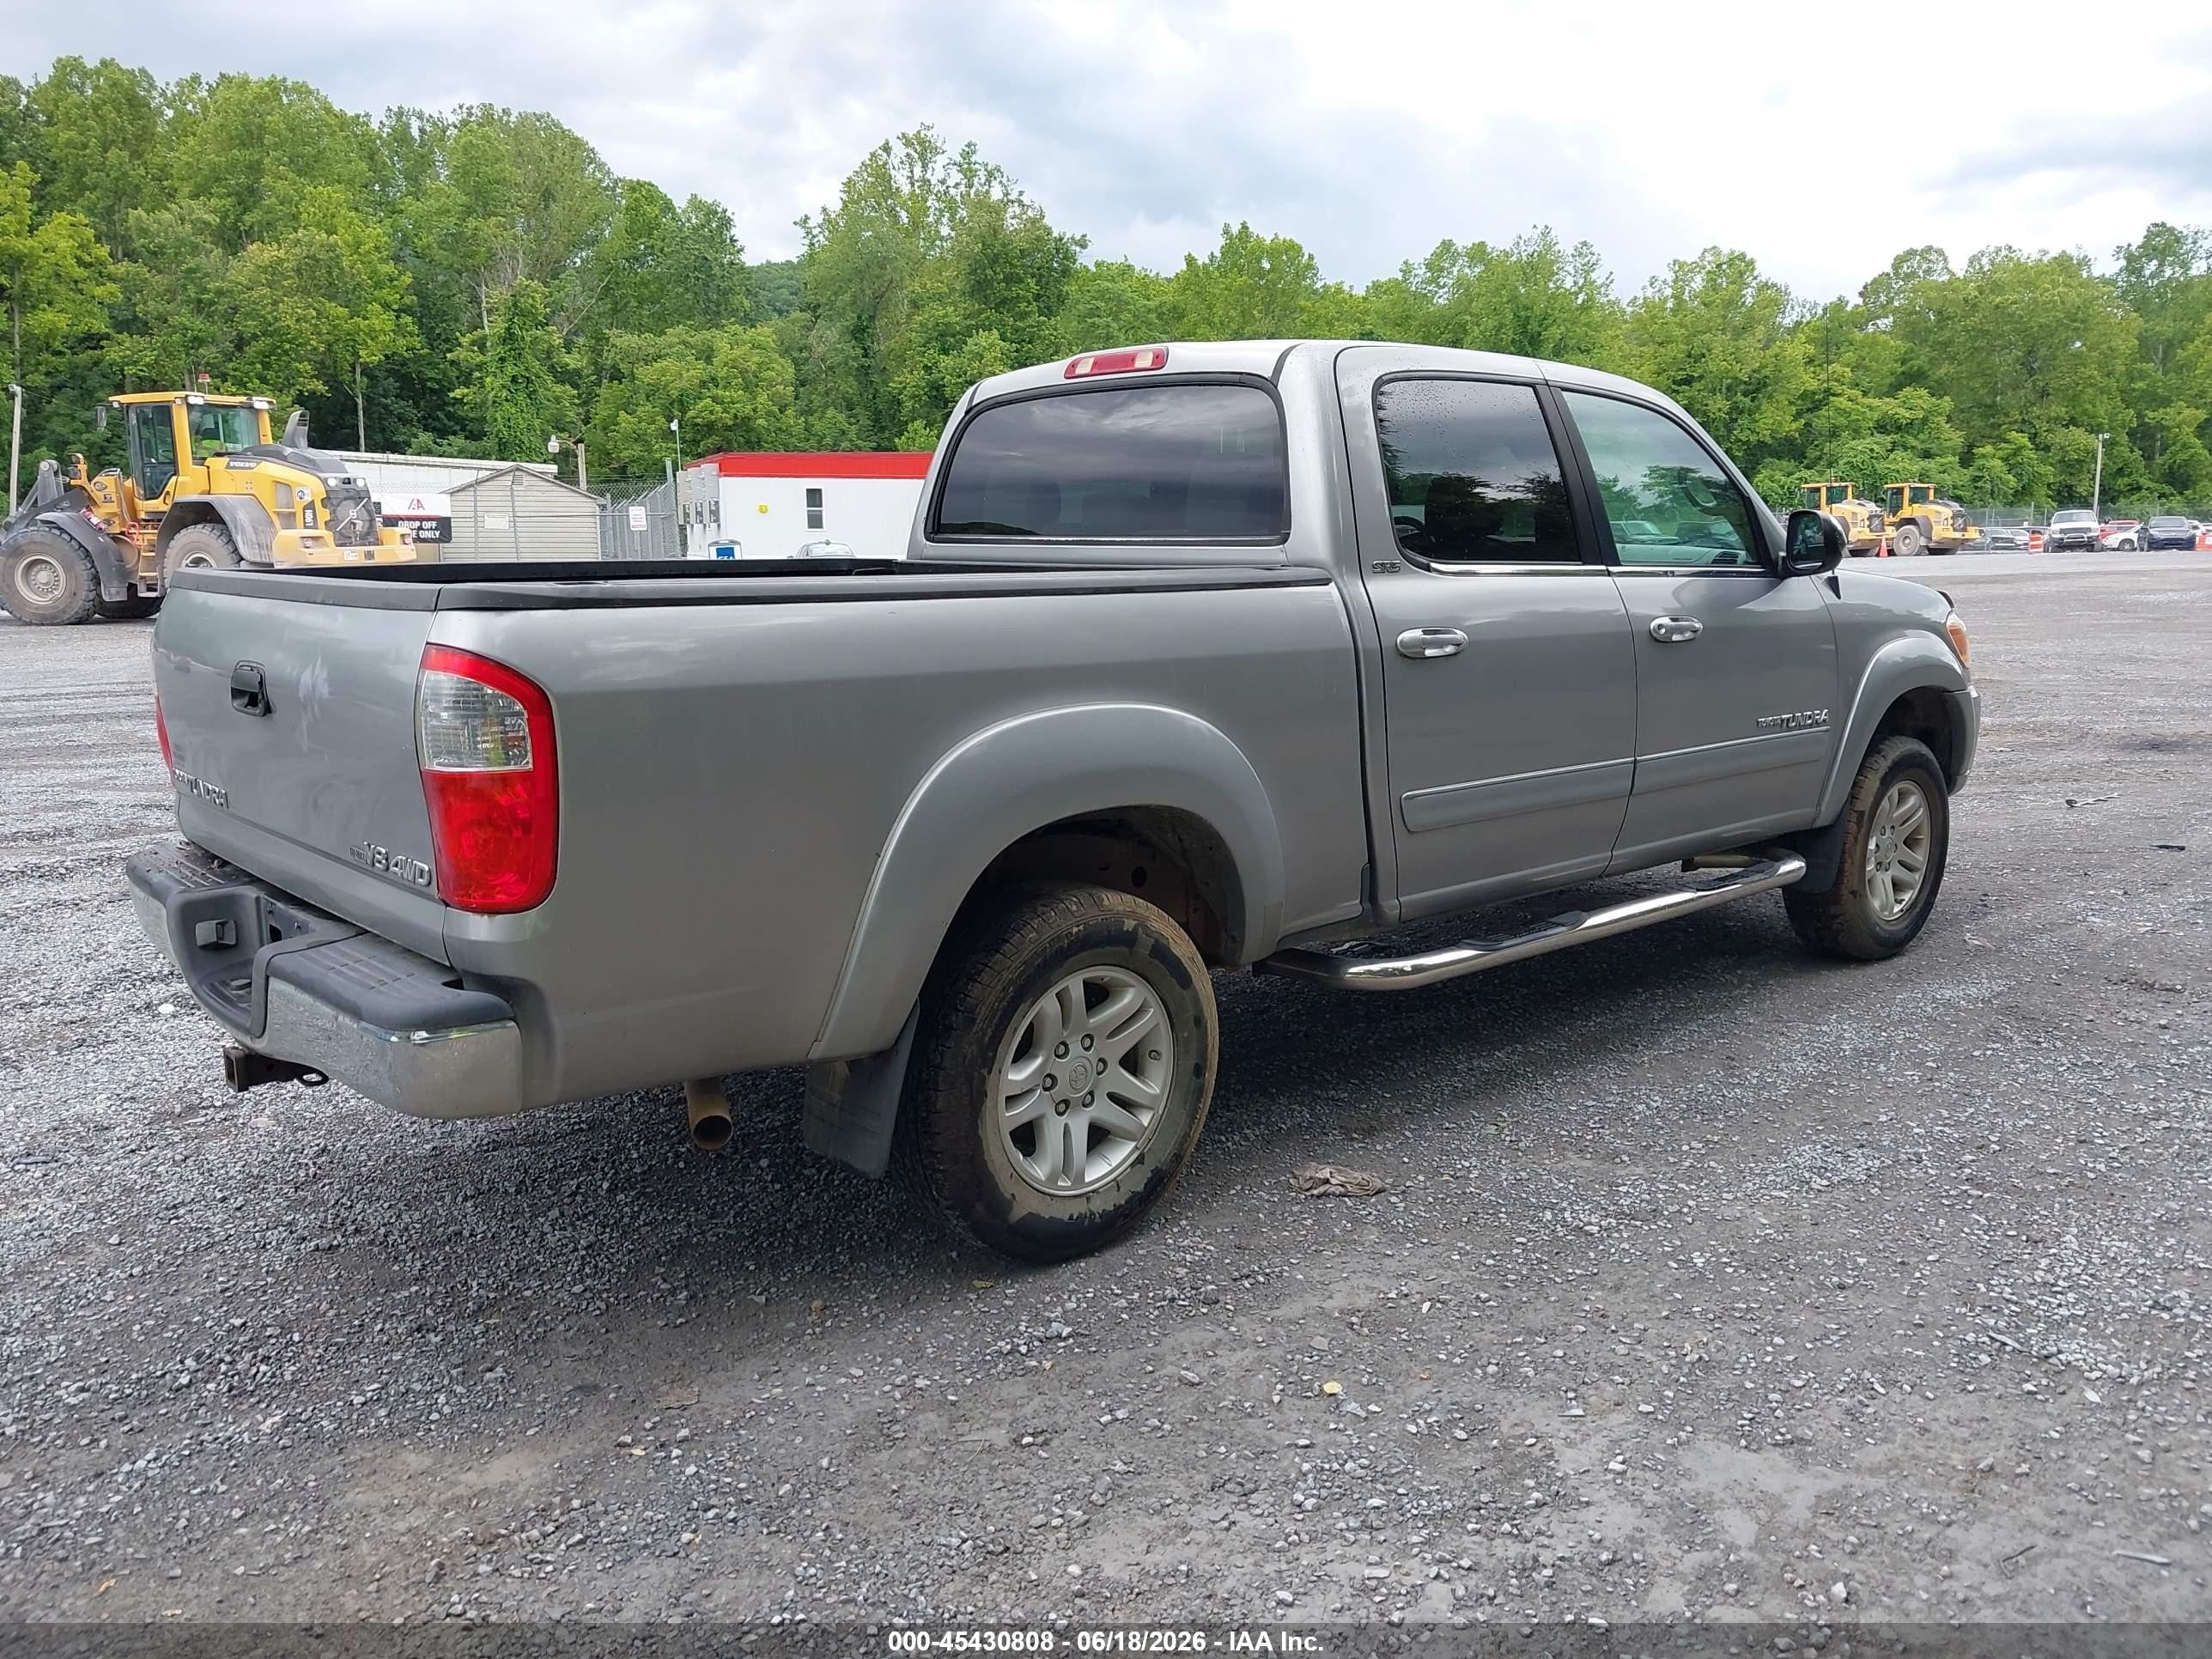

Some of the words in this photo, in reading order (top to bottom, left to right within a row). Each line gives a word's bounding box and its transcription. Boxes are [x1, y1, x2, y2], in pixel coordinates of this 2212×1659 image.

[305, 509, 313, 526] L90H
[398, 520, 421, 529] DROP
[419, 530, 441, 538] ONLY
[1373, 560, 1401, 574] SR5
[1781, 709, 1829, 728] TUNDRA
[364, 842, 389, 872] V8
[390, 855, 432, 887] 4WD
